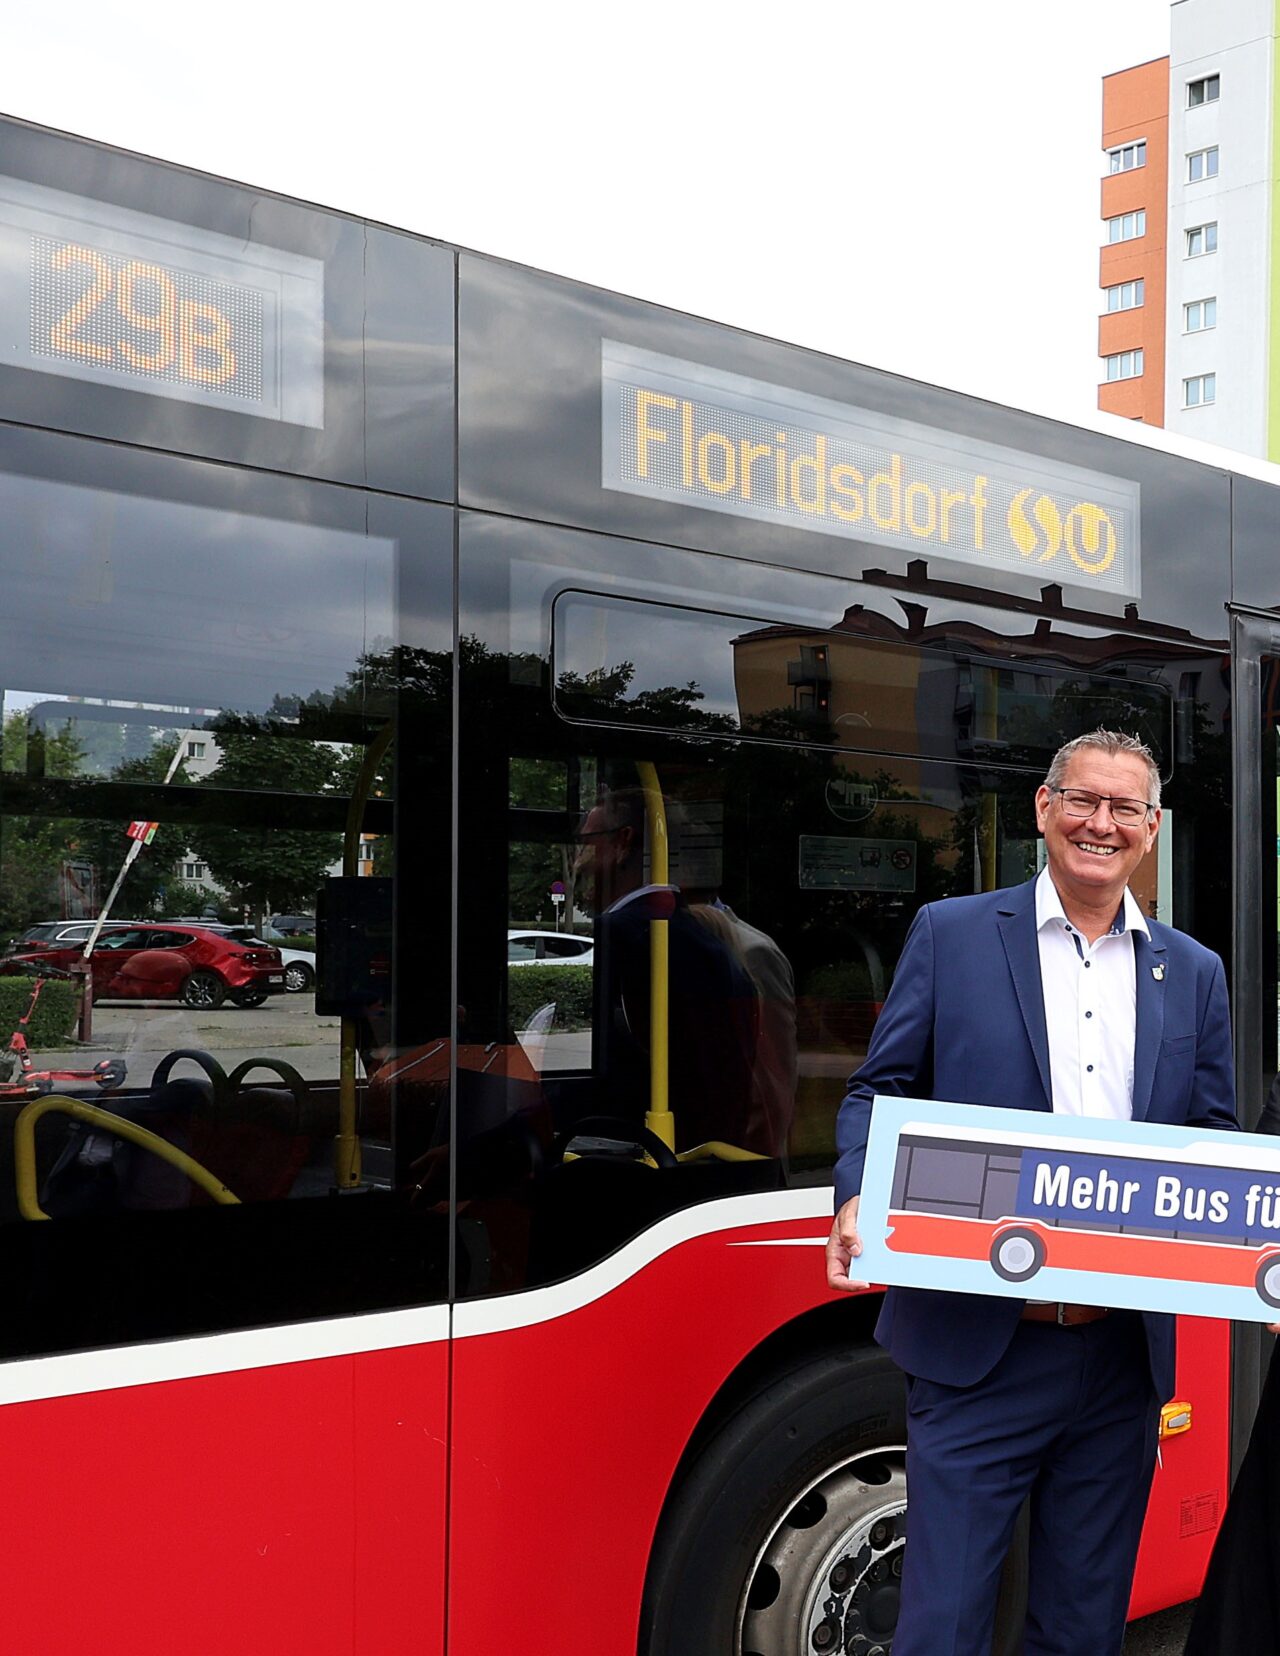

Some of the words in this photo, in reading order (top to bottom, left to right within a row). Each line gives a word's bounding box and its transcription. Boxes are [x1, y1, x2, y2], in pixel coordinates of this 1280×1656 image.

[50, 244, 237, 385] 29B
[635, 389, 988, 550] Floridsdorf
[1032, 1163, 1141, 1214] Mehr
[1154, 1175, 1230, 1224] Bus
